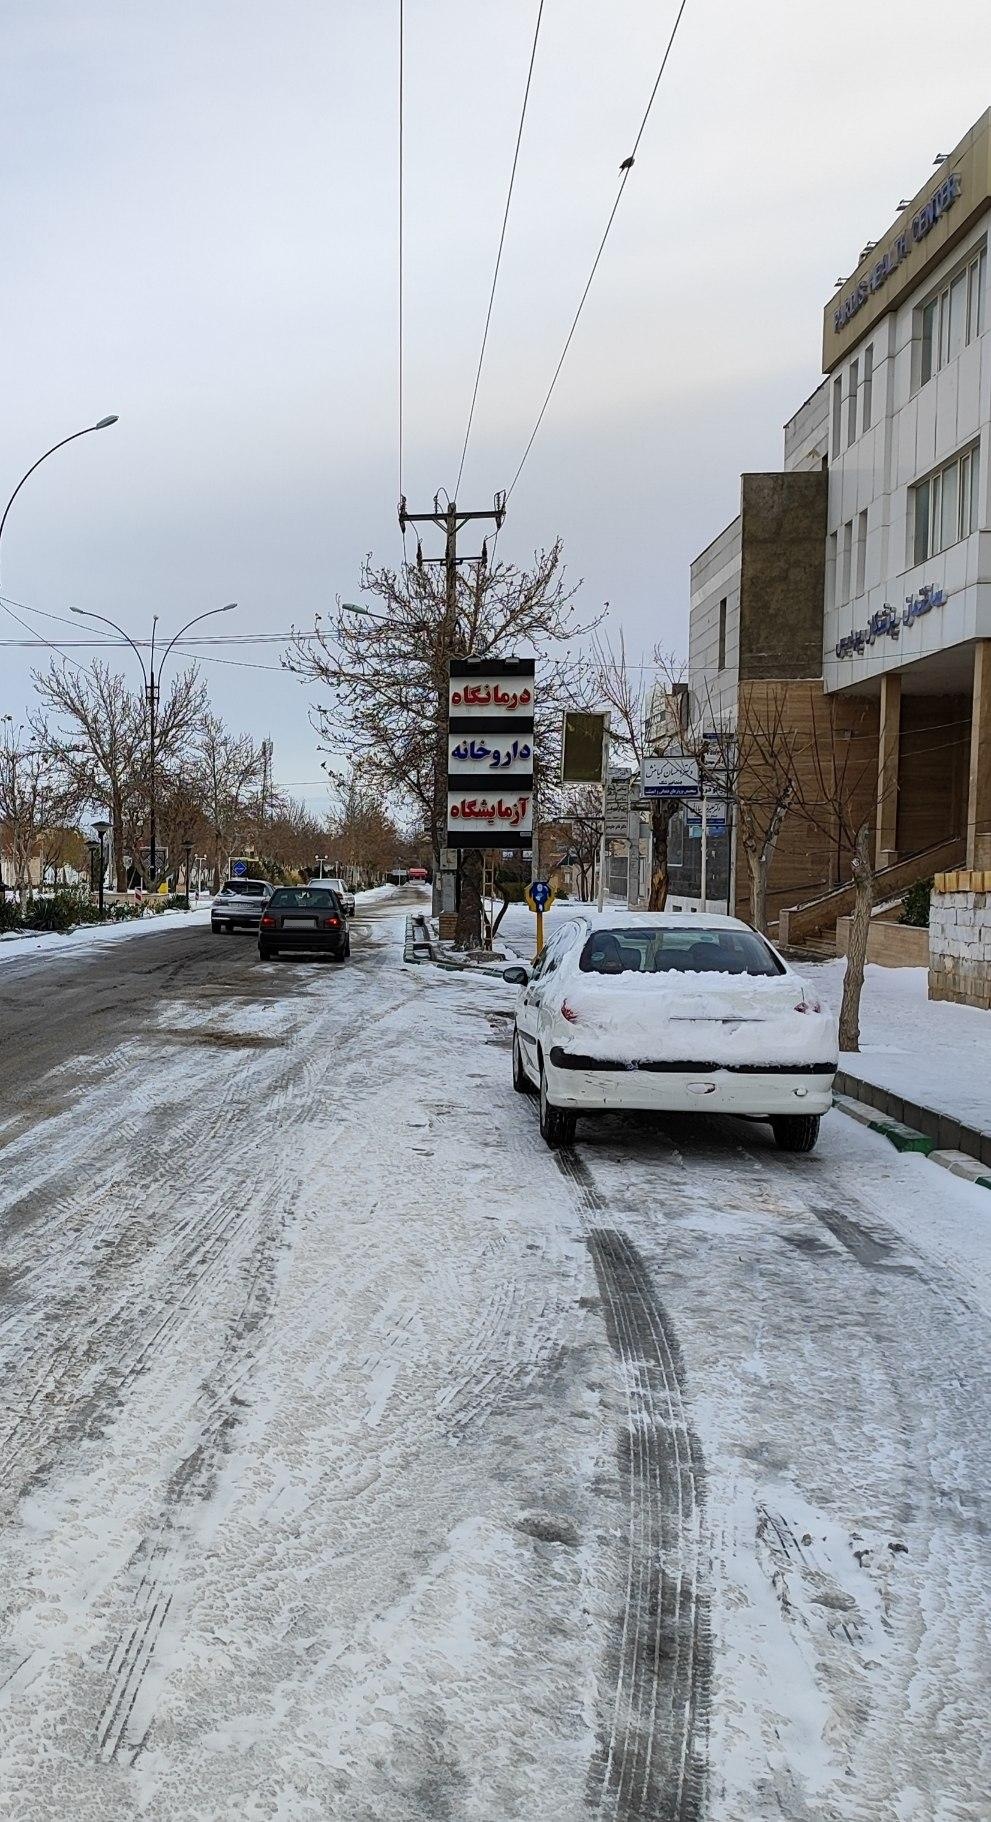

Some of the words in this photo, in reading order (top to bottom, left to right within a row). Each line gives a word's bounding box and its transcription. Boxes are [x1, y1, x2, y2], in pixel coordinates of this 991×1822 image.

[912, 173, 962, 242] CENTER
[451, 684, 532, 711] درمانگاه
[451, 740, 532, 769] داروخانه
[450, 796, 530, 827] آزمایشگاه
